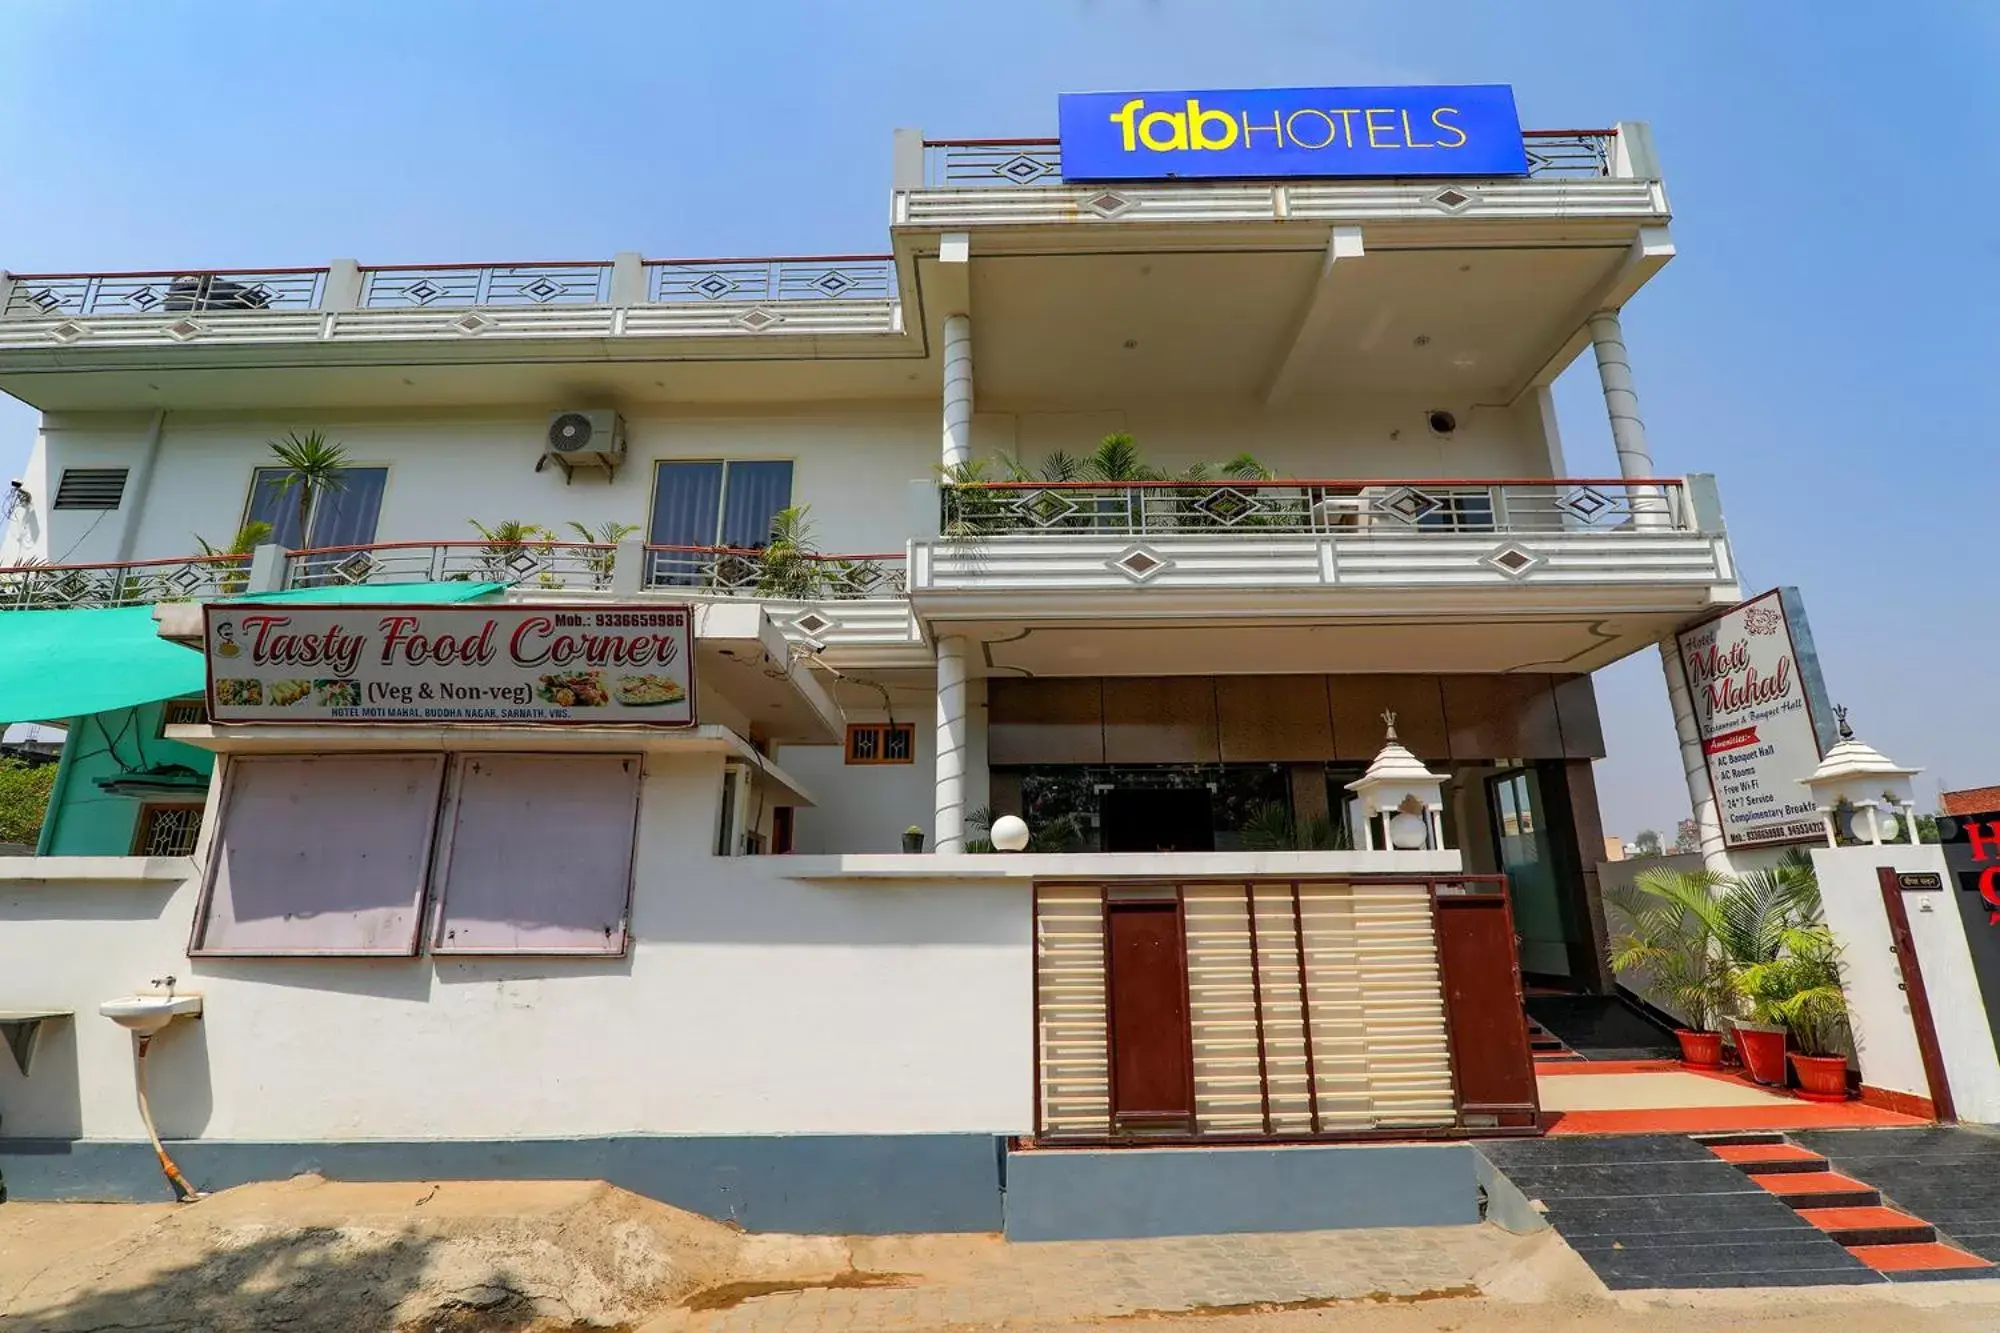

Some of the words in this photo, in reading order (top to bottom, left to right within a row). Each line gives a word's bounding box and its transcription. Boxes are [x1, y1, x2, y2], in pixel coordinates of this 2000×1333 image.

[555, 614, 592, 627] Mob.:
[595, 613, 684, 627] 9336659986
[242, 614, 368, 677] Tasty
[379, 614, 498, 669] Food
[509, 615, 678, 667] Corner
[1686, 632, 1715, 651] Hotel
[1689, 638, 1750, 687] Moti
[367, 681, 414, 704] (Veg
[418, 682, 435, 700] &
[439, 682, 534, 705] Non-veg)
[1701, 654, 1792, 720] Mahal
[331, 707, 360, 718] HOTEL
[361, 707, 386, 718] MOTI
[424, 707, 462, 718] BUDDHA
[1780, 697, 1802, 715] Hall
[1718, 756, 1728, 767] AC
[1729, 750, 1758, 764] Banquet
[1759, 744, 1775, 757] Hall
[1720, 769, 1731, 781] AC
[1731, 767, 1756, 779] Rooms
[1723, 784, 1740, 795] Free
[1746, 794, 1774, 806] Service
[1730, 808, 1784, 824] Complimentary
